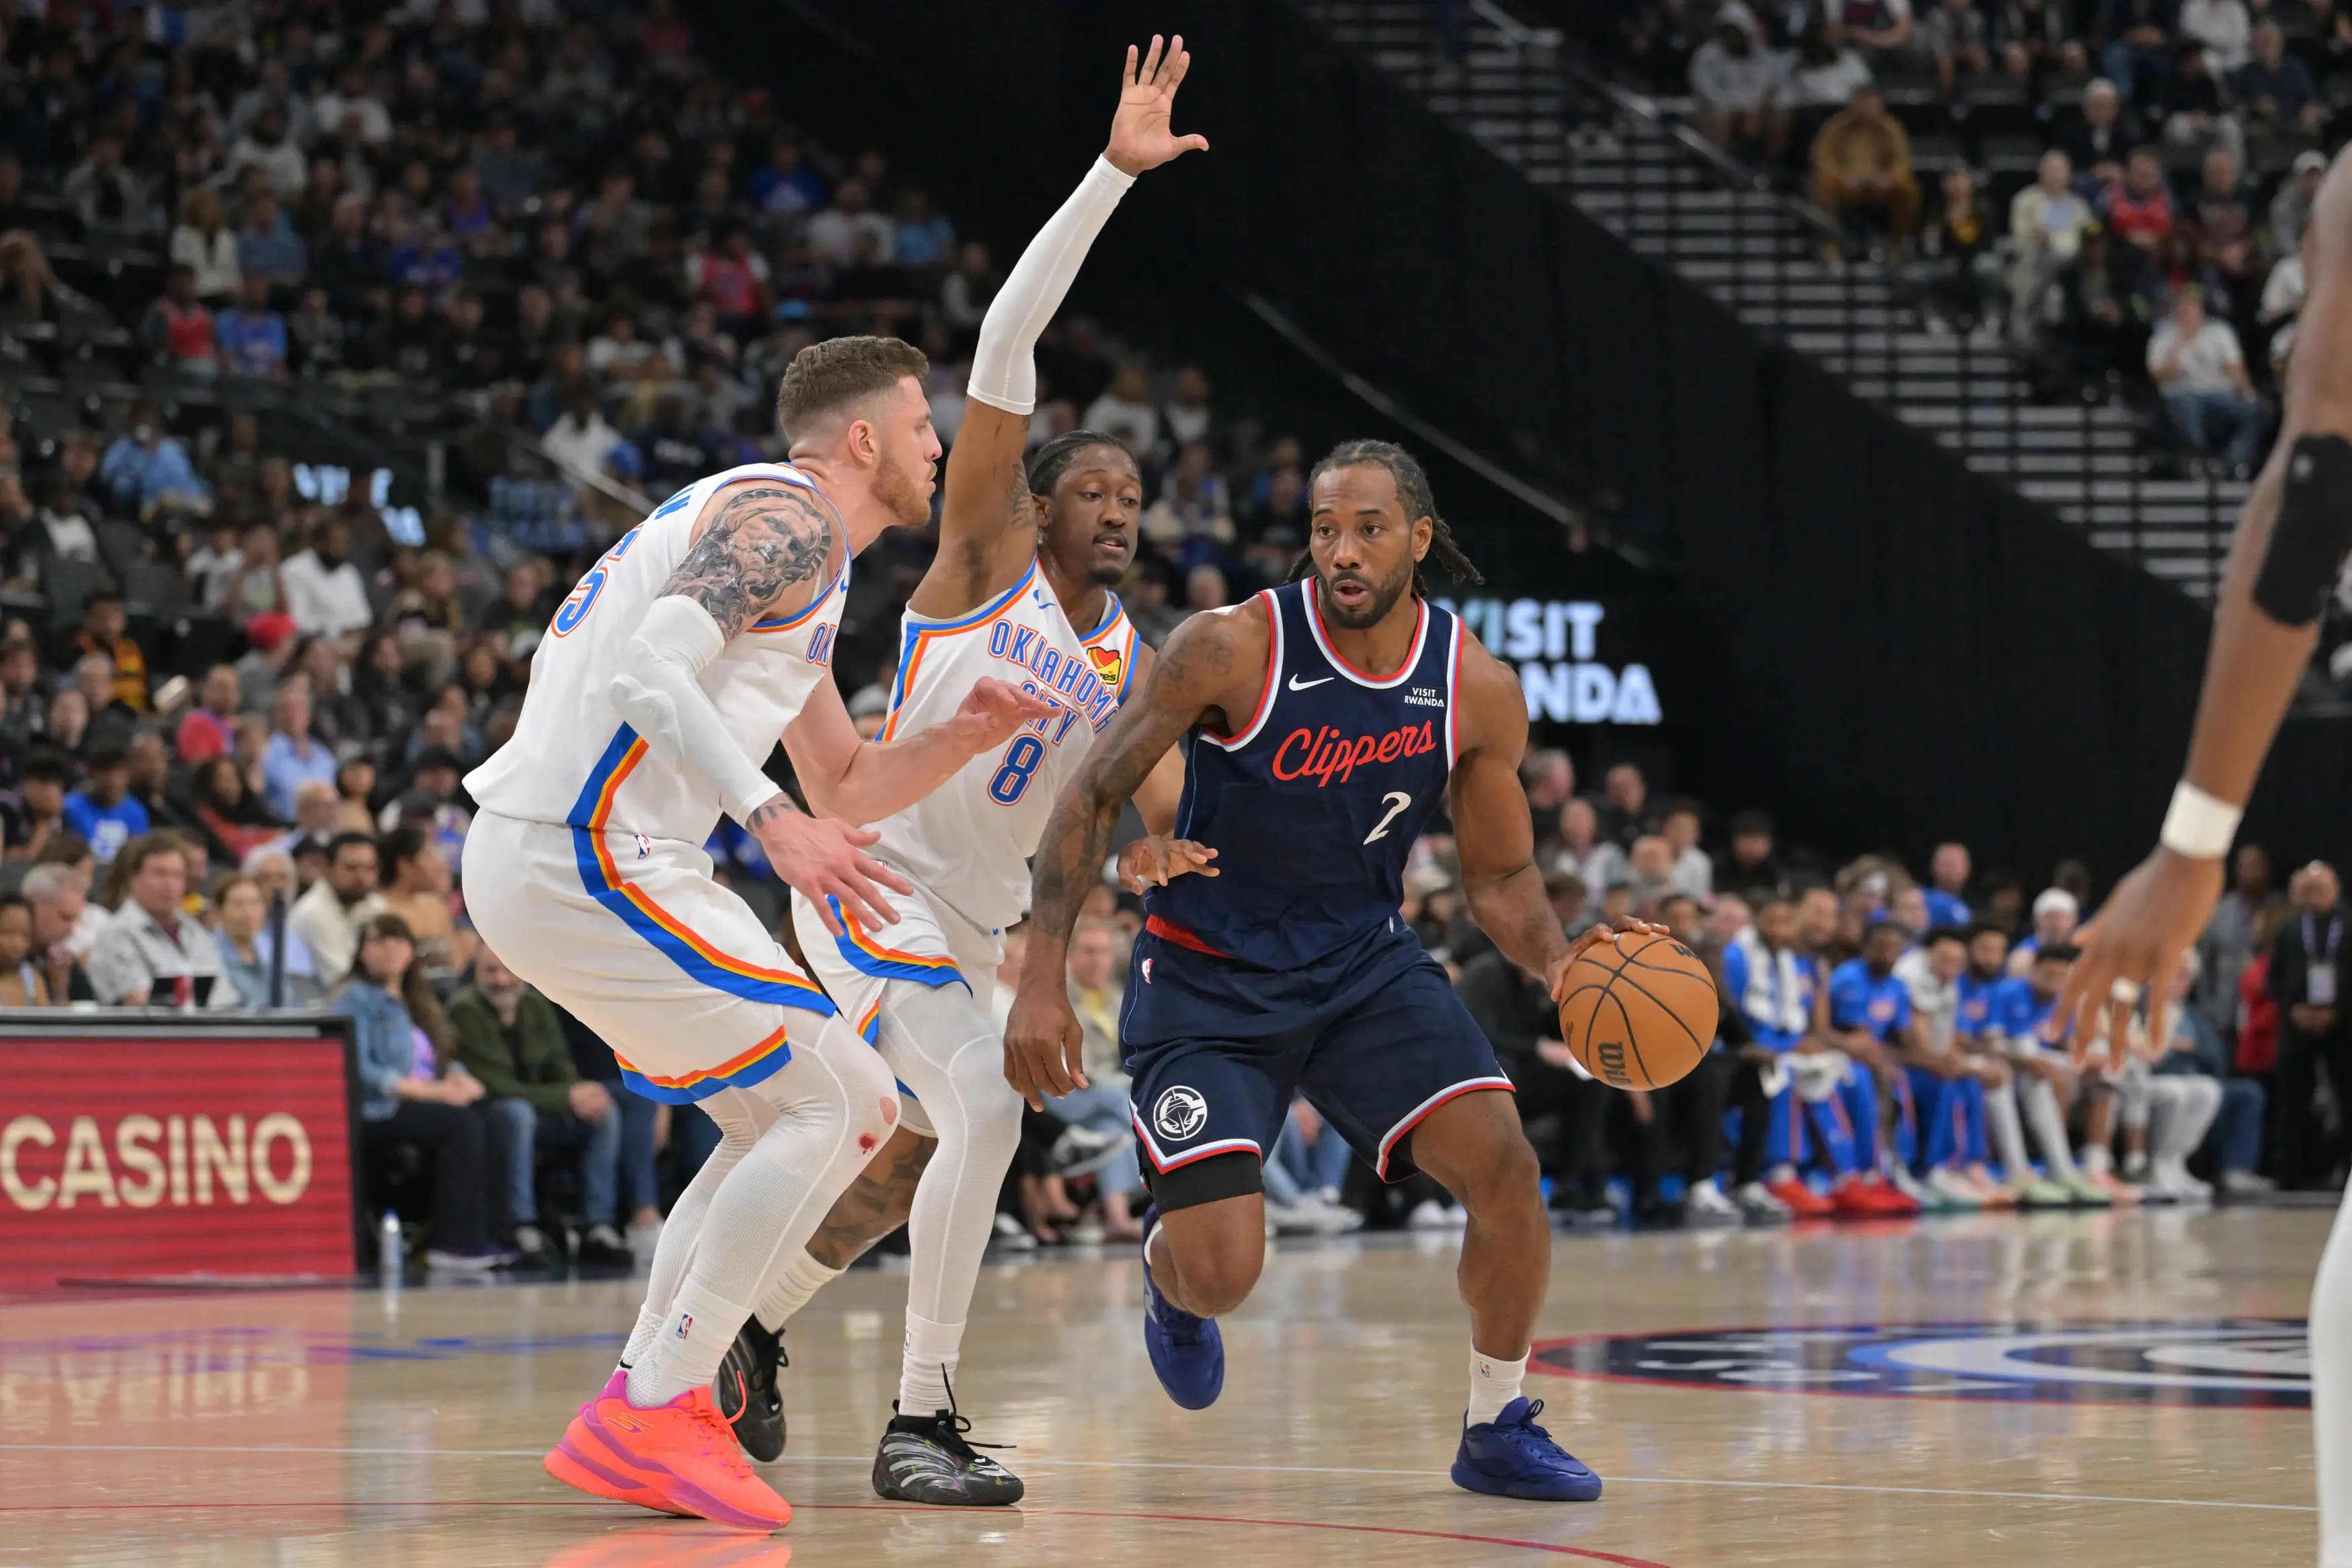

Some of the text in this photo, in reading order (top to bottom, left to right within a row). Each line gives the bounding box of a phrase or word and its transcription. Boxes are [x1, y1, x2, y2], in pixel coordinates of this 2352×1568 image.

[1404, 695, 1445, 707] RWANDA
[1412, 687, 1436, 697] VISIT
[1519, 660, 1663, 726] NDA
[987, 733, 1047, 806] 8
[1272, 719, 1437, 788] Clippers
[1363, 791, 1411, 846] 2
[0, 1112, 312, 1211] CASINO
